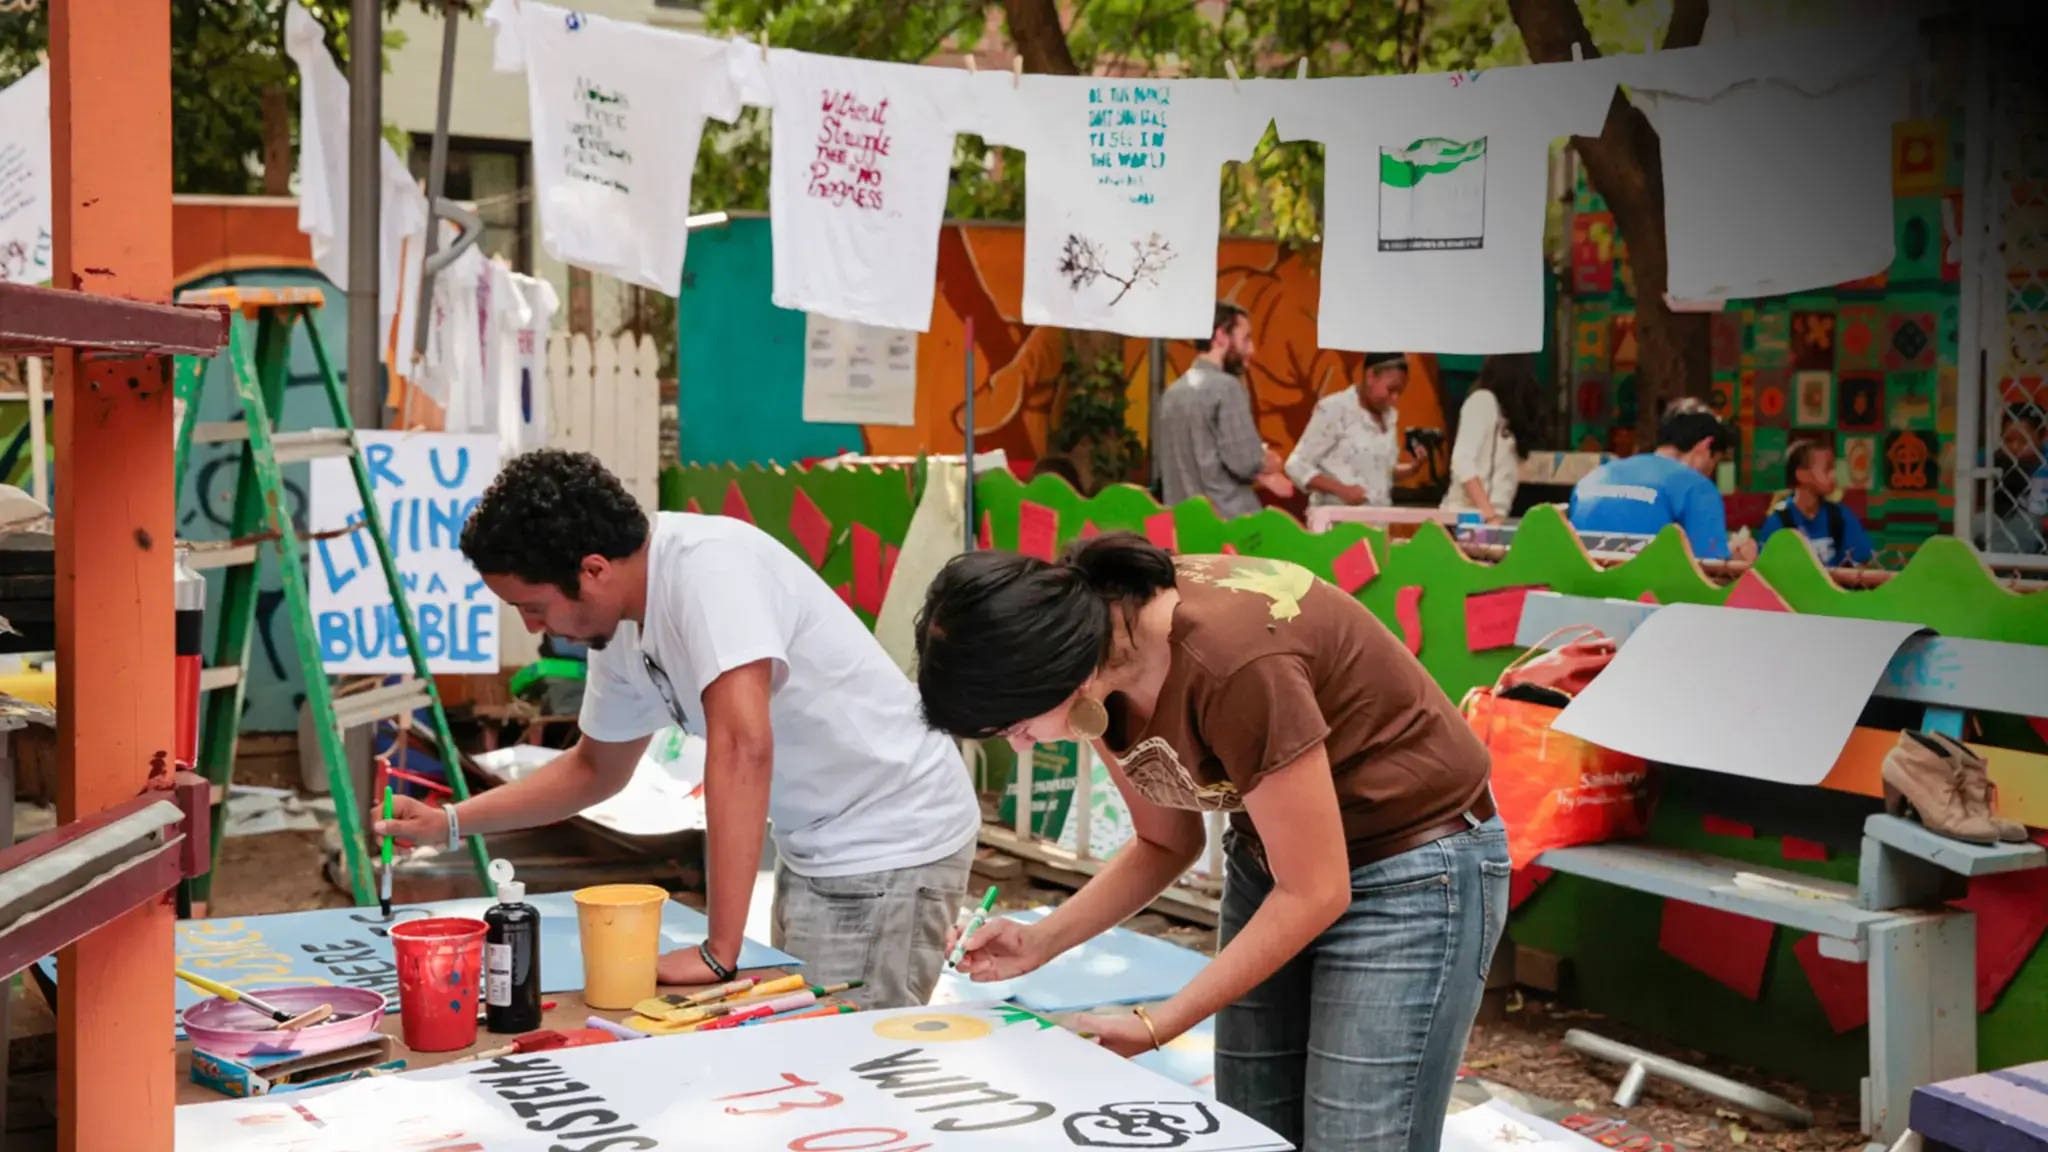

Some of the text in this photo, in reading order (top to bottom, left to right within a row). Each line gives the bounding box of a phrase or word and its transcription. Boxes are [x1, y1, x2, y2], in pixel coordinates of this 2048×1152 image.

[366, 443, 469, 489] R U
[318, 602, 493, 663] BUBBLE
[849, 1048, 1057, 1132] CLIMA
